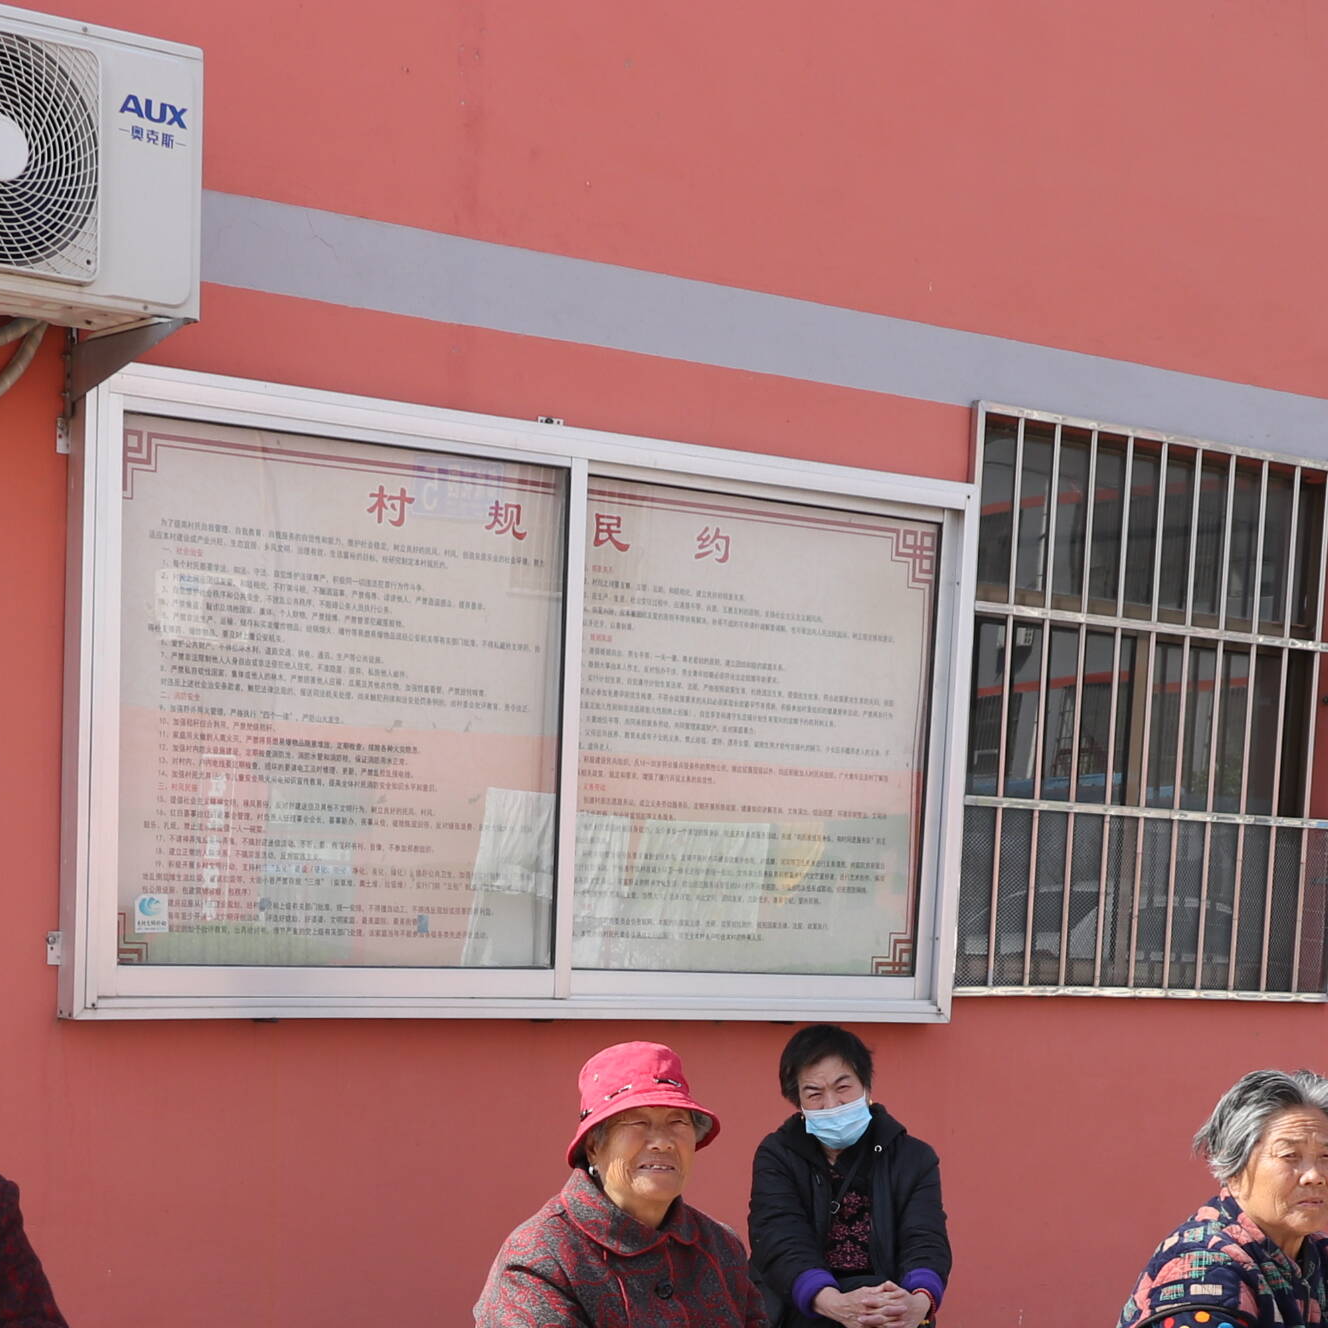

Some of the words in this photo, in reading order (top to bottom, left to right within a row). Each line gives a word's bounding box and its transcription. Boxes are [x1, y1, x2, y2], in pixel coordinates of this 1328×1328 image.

[119, 94, 188, 130] AUX
[131, 125, 175, 149] 奥克斯
